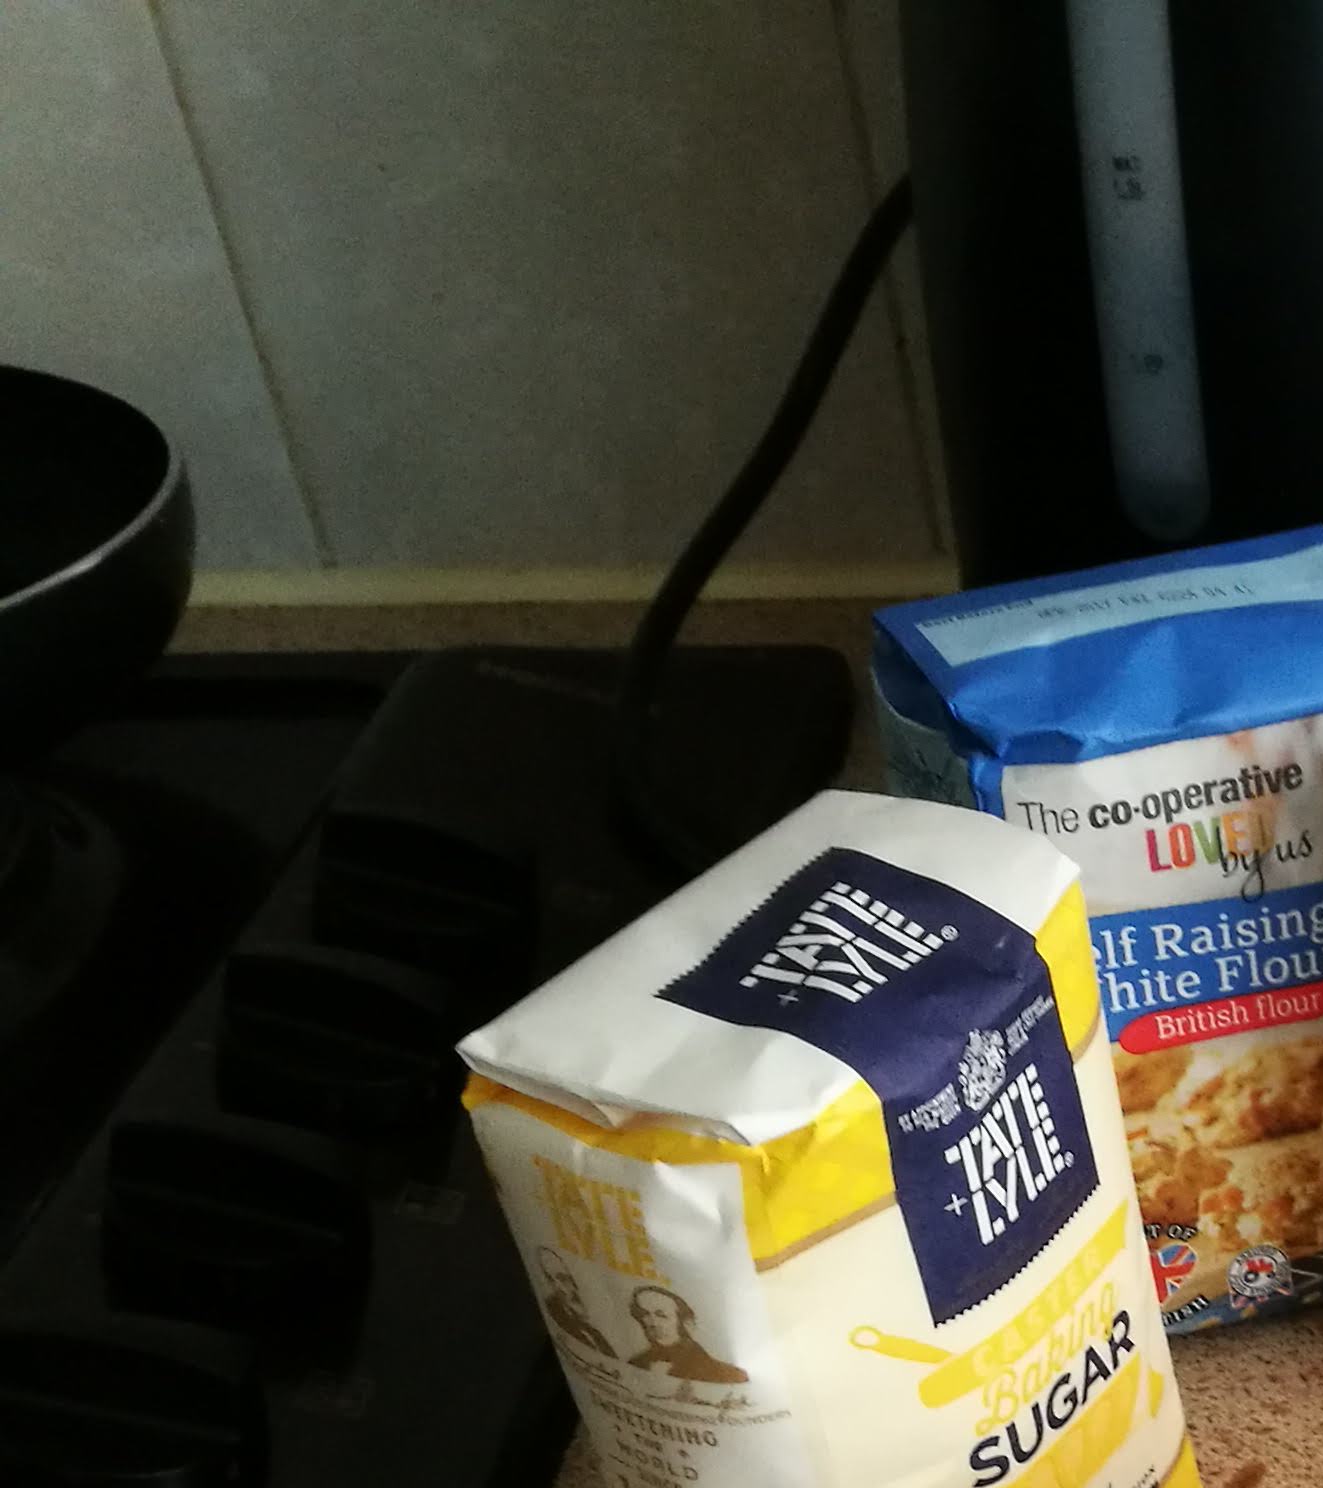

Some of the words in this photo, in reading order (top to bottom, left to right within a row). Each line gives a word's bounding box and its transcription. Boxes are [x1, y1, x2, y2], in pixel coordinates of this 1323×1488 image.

[1017, 801, 1080, 835] The
[1088, 761, 1303, 829] co-operative
[739, 881, 890, 988] TATE
[803, 908, 944, 1003] LYLE
[1097, 968, 1202, 1014] hite
[1154, 1001, 1250, 1041] British
[1254, 992, 1323, 1020] flour
[944, 1062, 1054, 1193] TATE
[970, 1110, 1066, 1247] LYLE
[968, 1309, 1136, 1488] SUGAR
